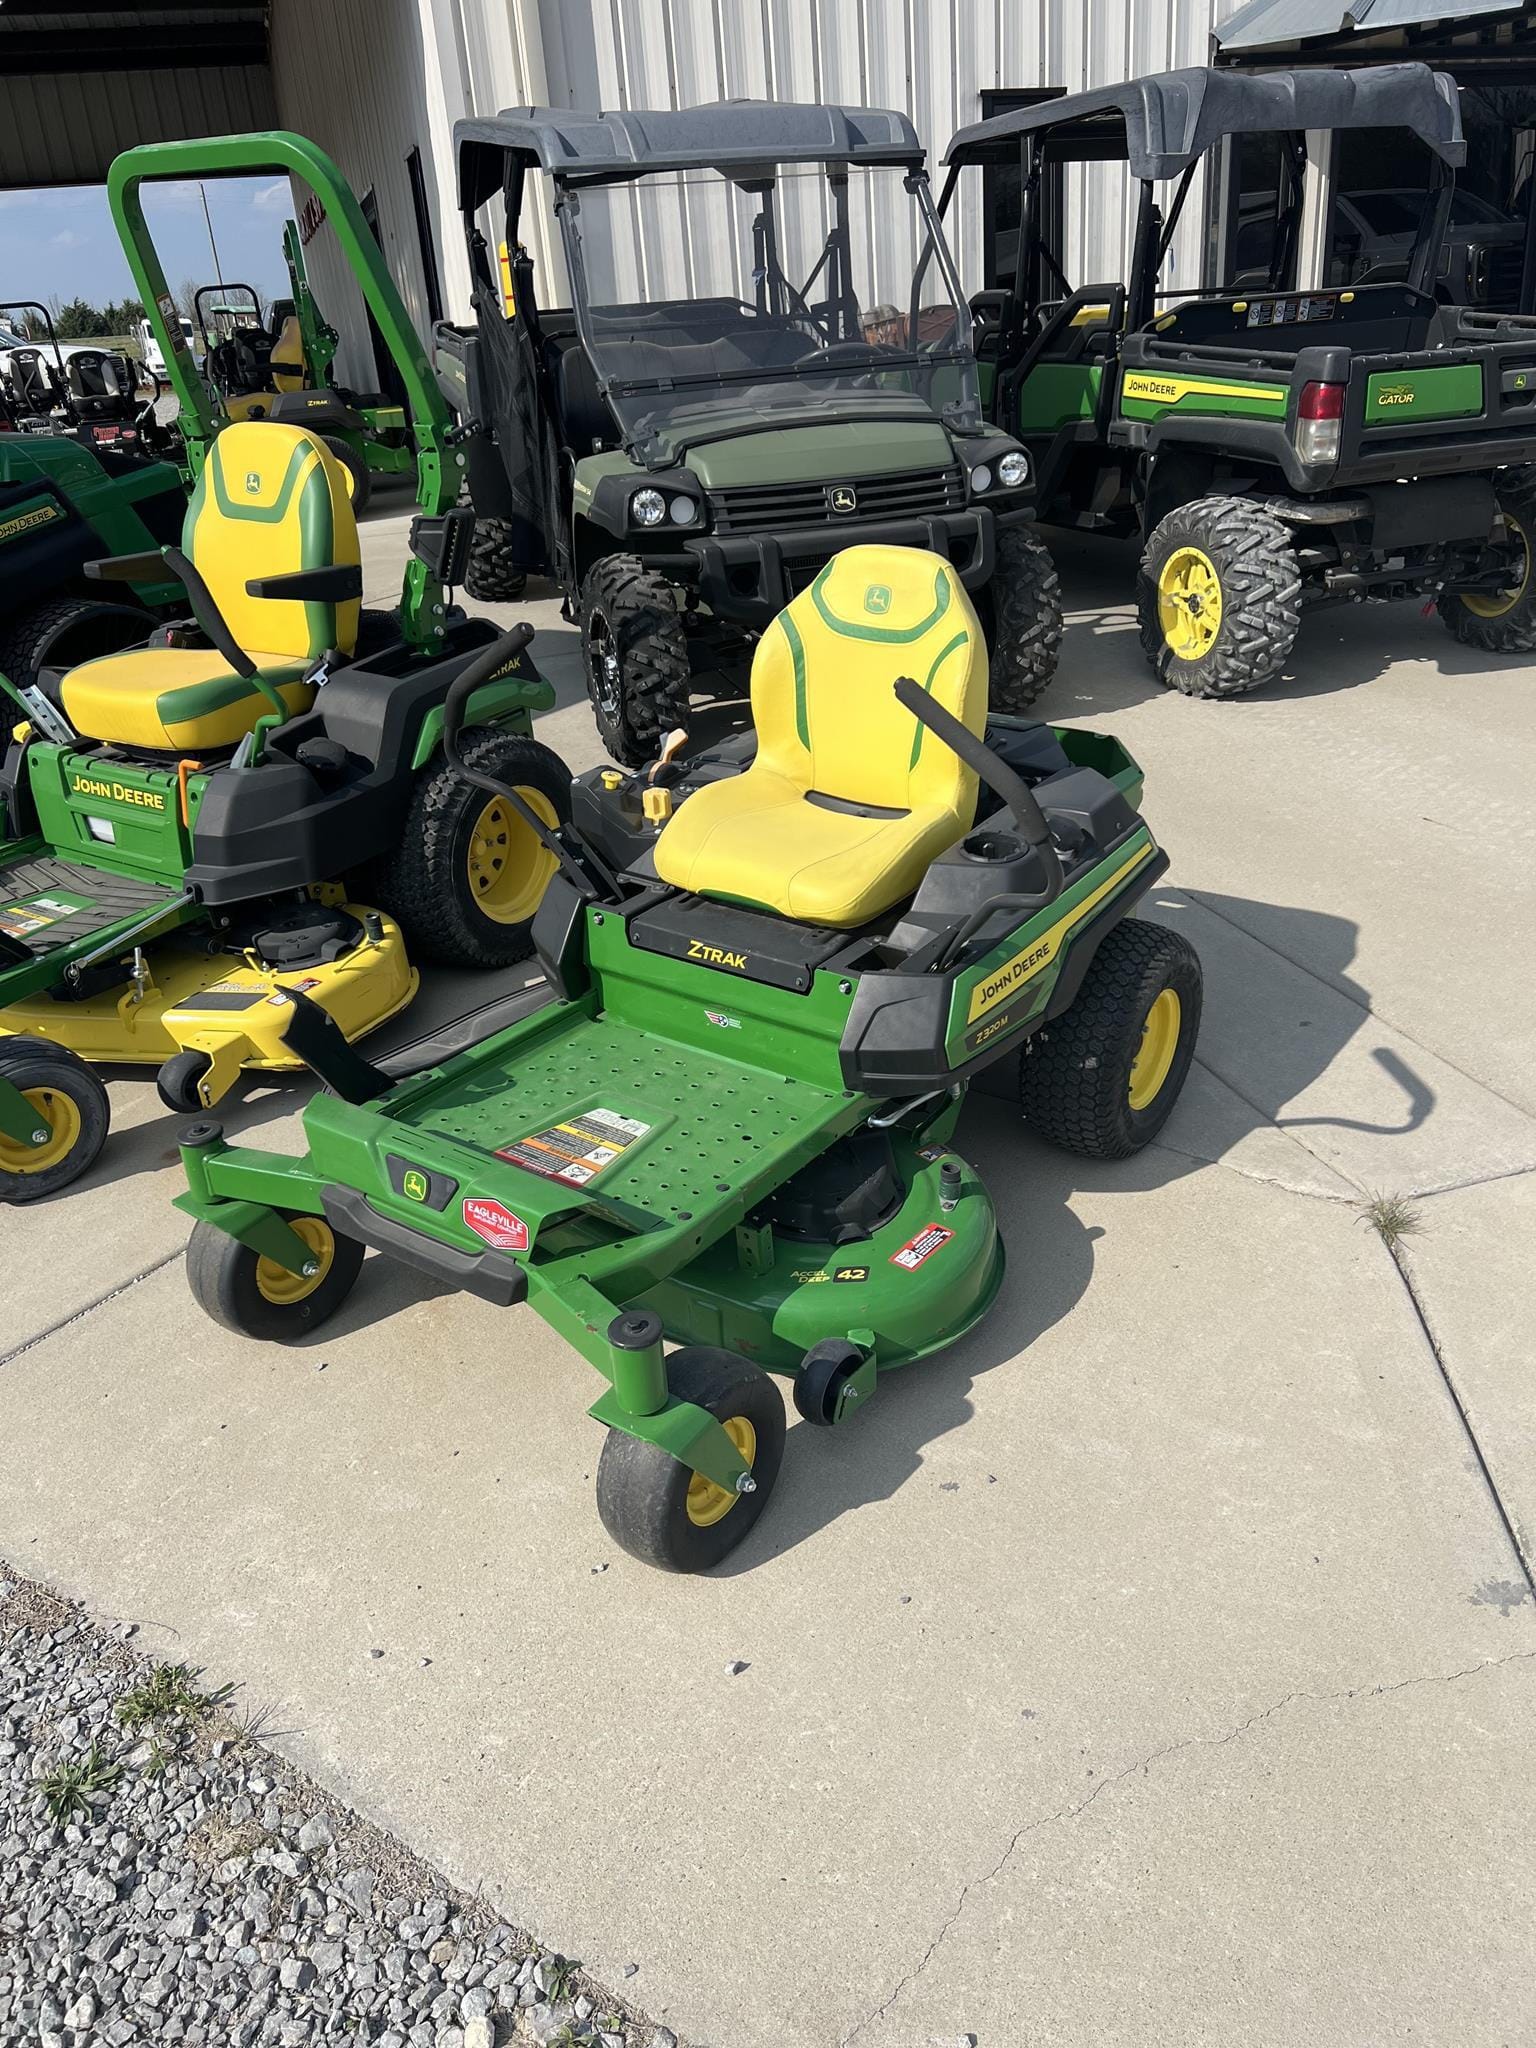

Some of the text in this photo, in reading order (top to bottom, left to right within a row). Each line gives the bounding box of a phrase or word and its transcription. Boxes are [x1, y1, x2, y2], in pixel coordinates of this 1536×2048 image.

[1128, 379, 1176, 396] JOHN DEERE
[1378, 393, 1414, 405] GATOR
[19, 510, 51, 528] DEERE
[73, 774, 165, 810] JOHN DEERE
[687, 939, 748, 969] ZTRAK
[980, 942, 1051, 1004] JOHN DEERE
[975, 1015, 1009, 1045] Z320M
[467, 1201, 524, 1233] EAGLEVILLE
[790, 1270, 828, 1278] ACCEL
[837, 1269, 866, 1280] 42
